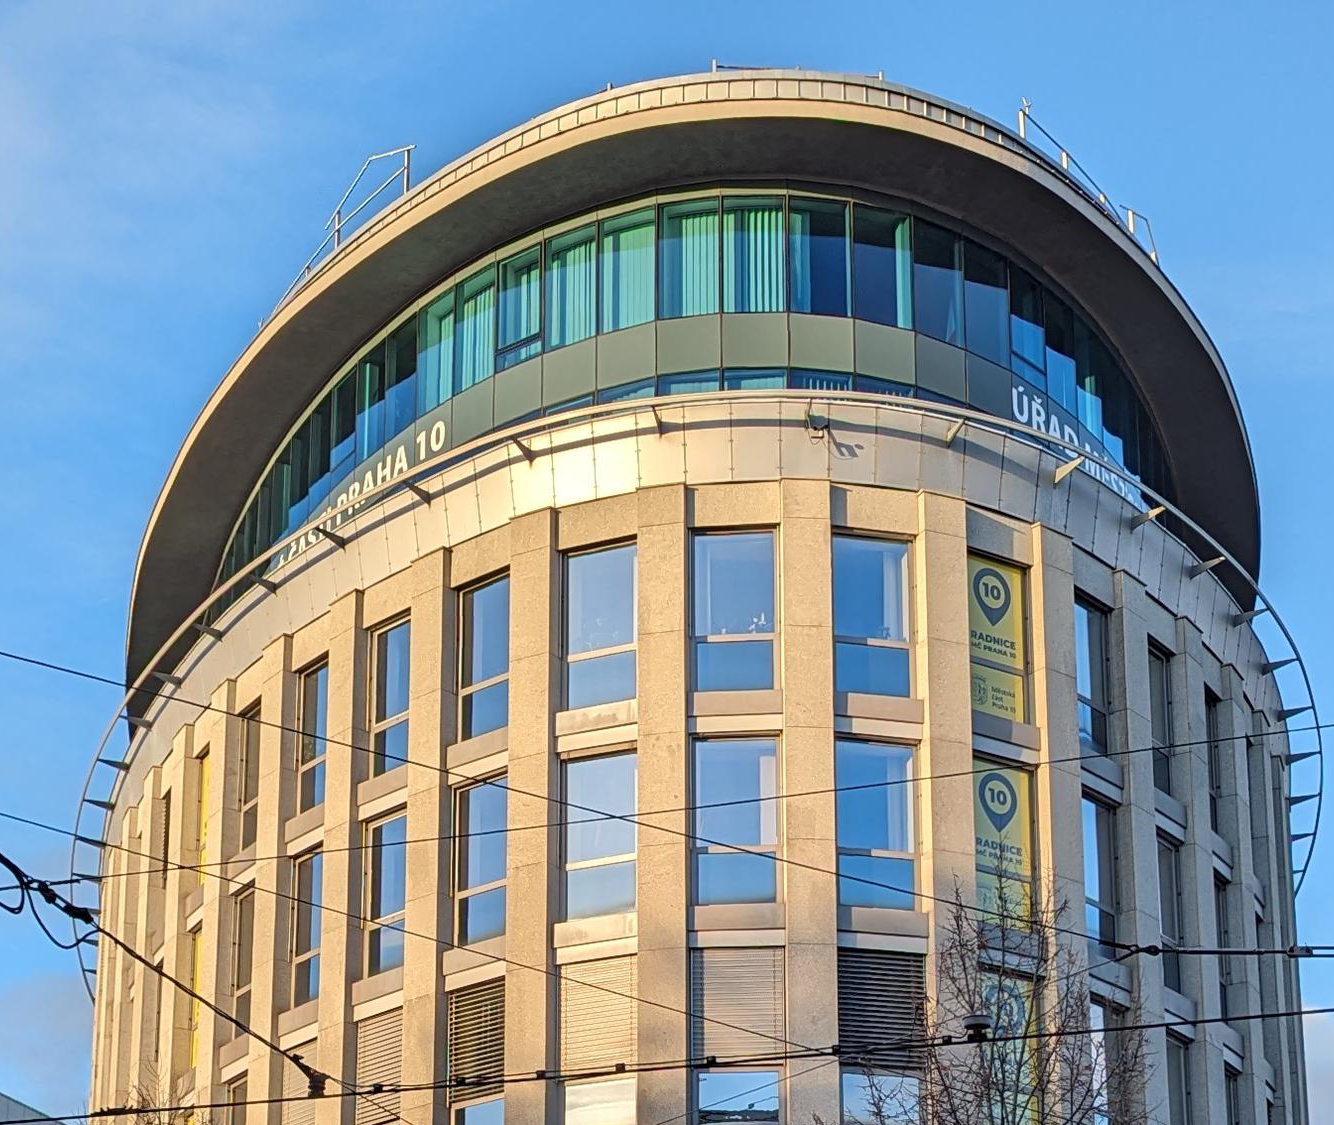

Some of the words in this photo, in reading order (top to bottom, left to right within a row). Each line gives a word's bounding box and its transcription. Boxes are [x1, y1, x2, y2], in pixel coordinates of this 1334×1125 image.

[1012, 385, 1079, 458] ÚŘAD
[335, 445, 408, 526] PRAHA
[417, 420, 445, 460] 10
[982, 582, 1002, 601] 10
[970, 630, 1017, 651] RADNICE
[988, 787, 1008, 806] 10
